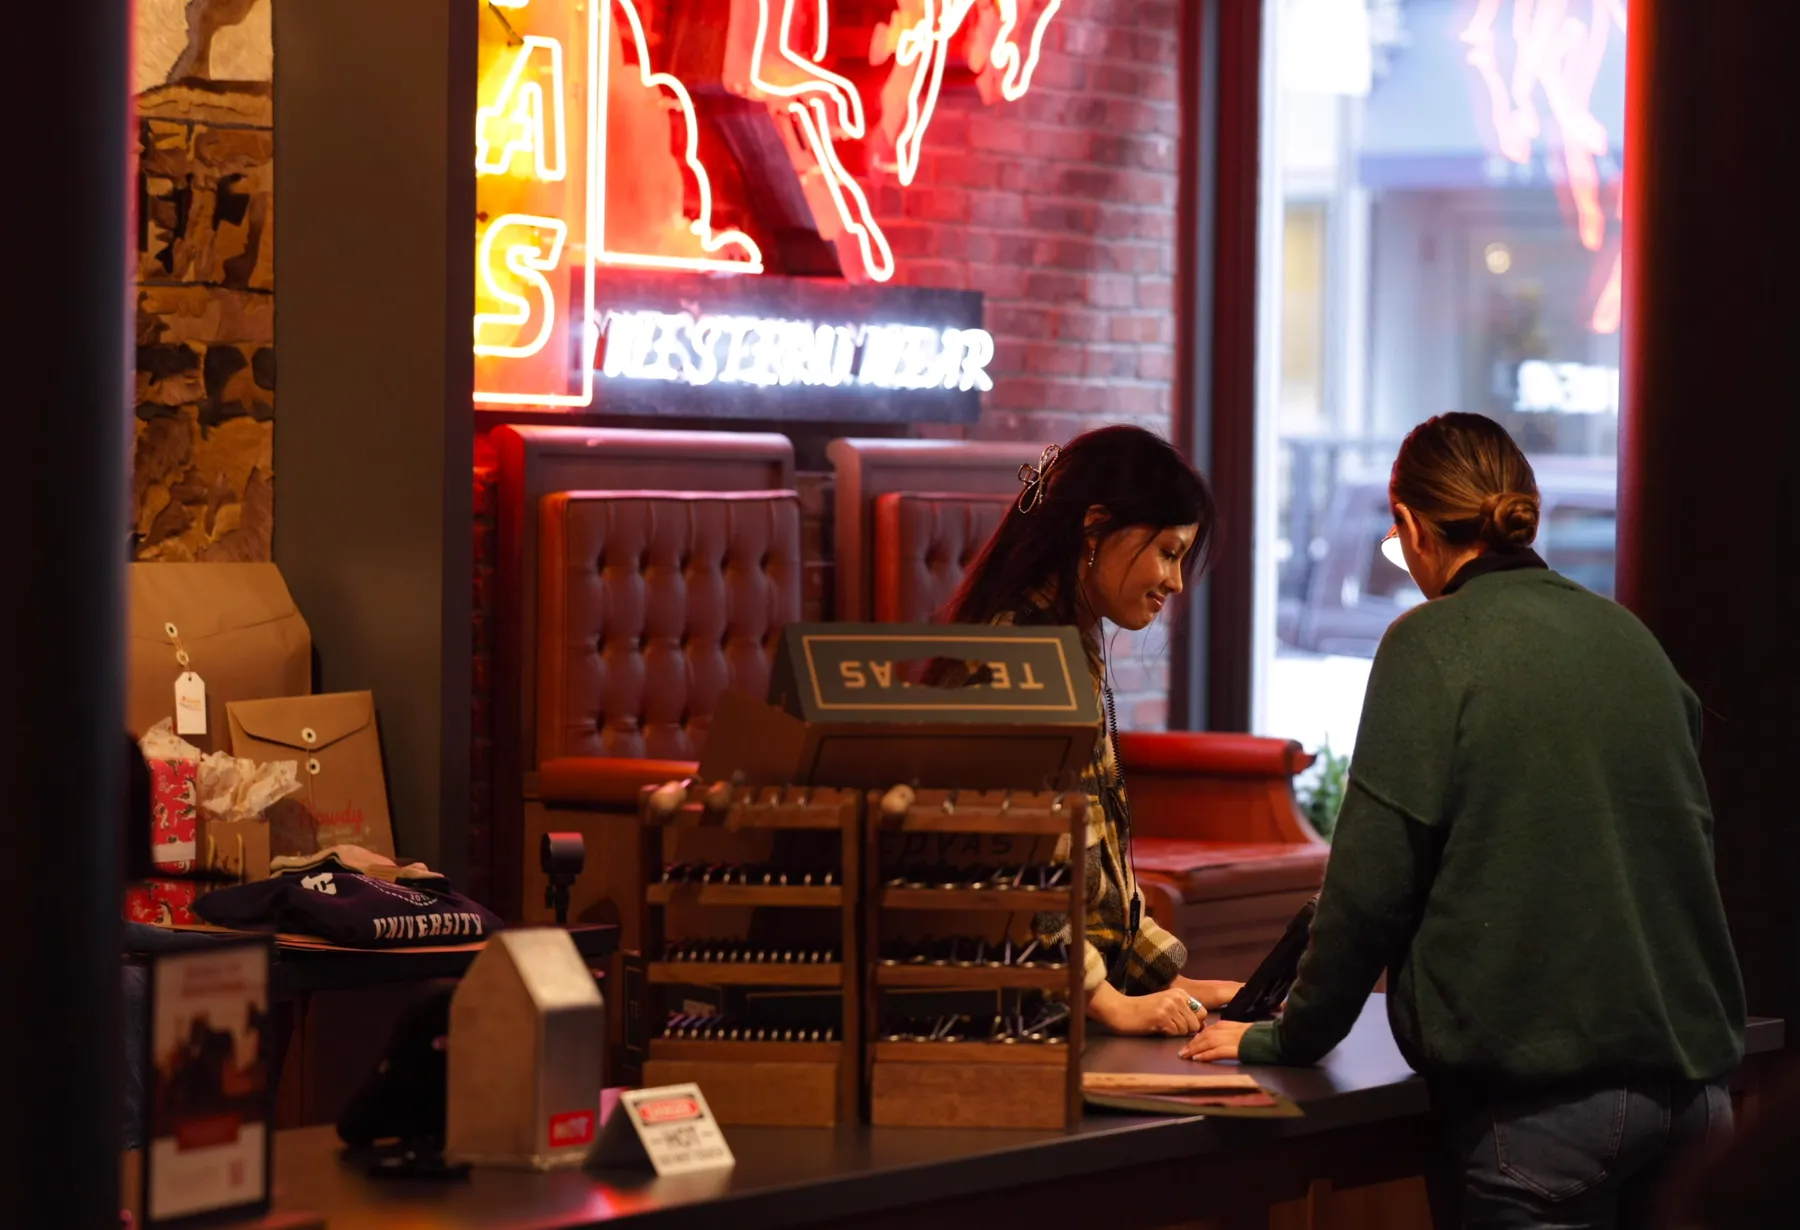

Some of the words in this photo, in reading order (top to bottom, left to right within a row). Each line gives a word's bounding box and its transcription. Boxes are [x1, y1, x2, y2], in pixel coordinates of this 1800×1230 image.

[473, 0, 567, 358] AS
[598, 311, 856, 388] WESTERN
[859, 322, 995, 392] WEAR
[839, 660, 1045, 690] TEAS
[374, 912, 484, 940] UNIVERSITY
